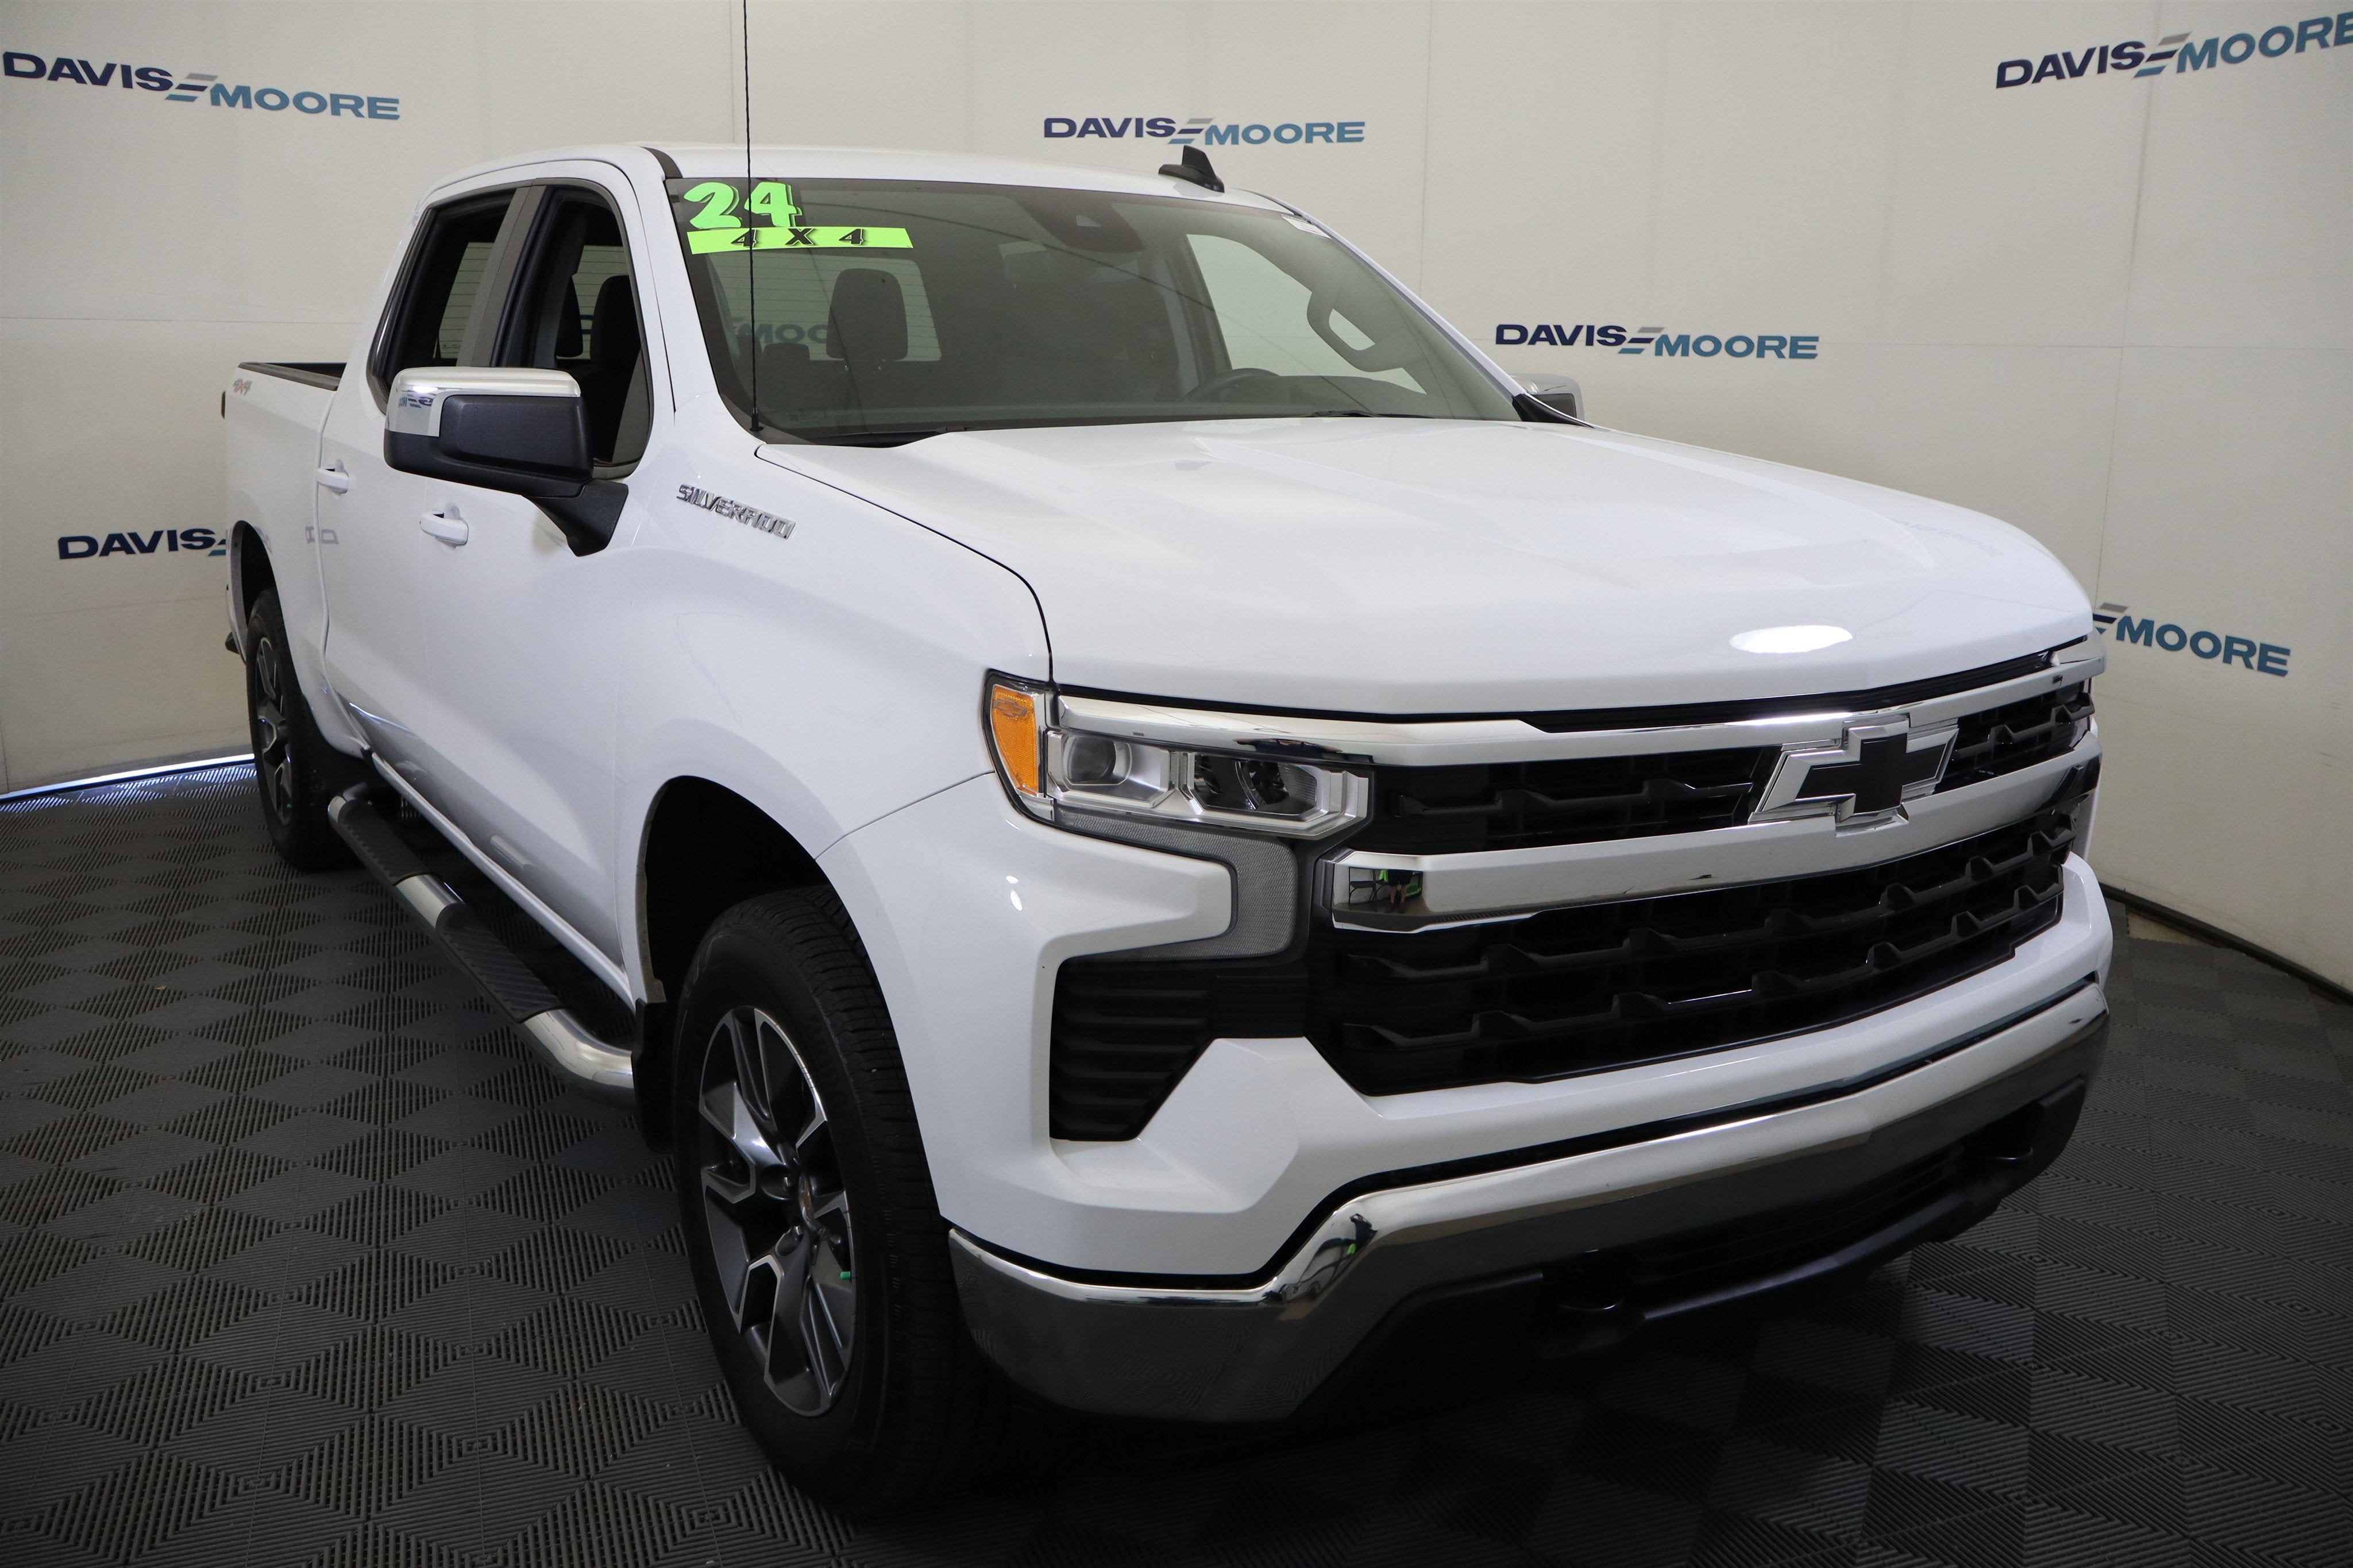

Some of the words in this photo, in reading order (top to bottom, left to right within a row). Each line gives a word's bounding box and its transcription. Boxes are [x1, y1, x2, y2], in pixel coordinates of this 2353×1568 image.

[3, 51, 173, 92] DAVIS
[210, 83, 400, 120] MOORE
[1996, 41, 2147, 88] DAVIS
[1044, 117, 1176, 138] DAVIS
[1205, 121, 1365, 145] MOORE
[684, 181, 803, 229] 24
[738, 323, 828, 343] MOO
[1495, 324, 1629, 346] DAVIS
[1654, 334, 1819, 360] MOORE
[676, 484, 796, 540] SILVERADO
[57, 528, 216, 559] DAVIS
[2116, 615, 2291, 677] MOORE
